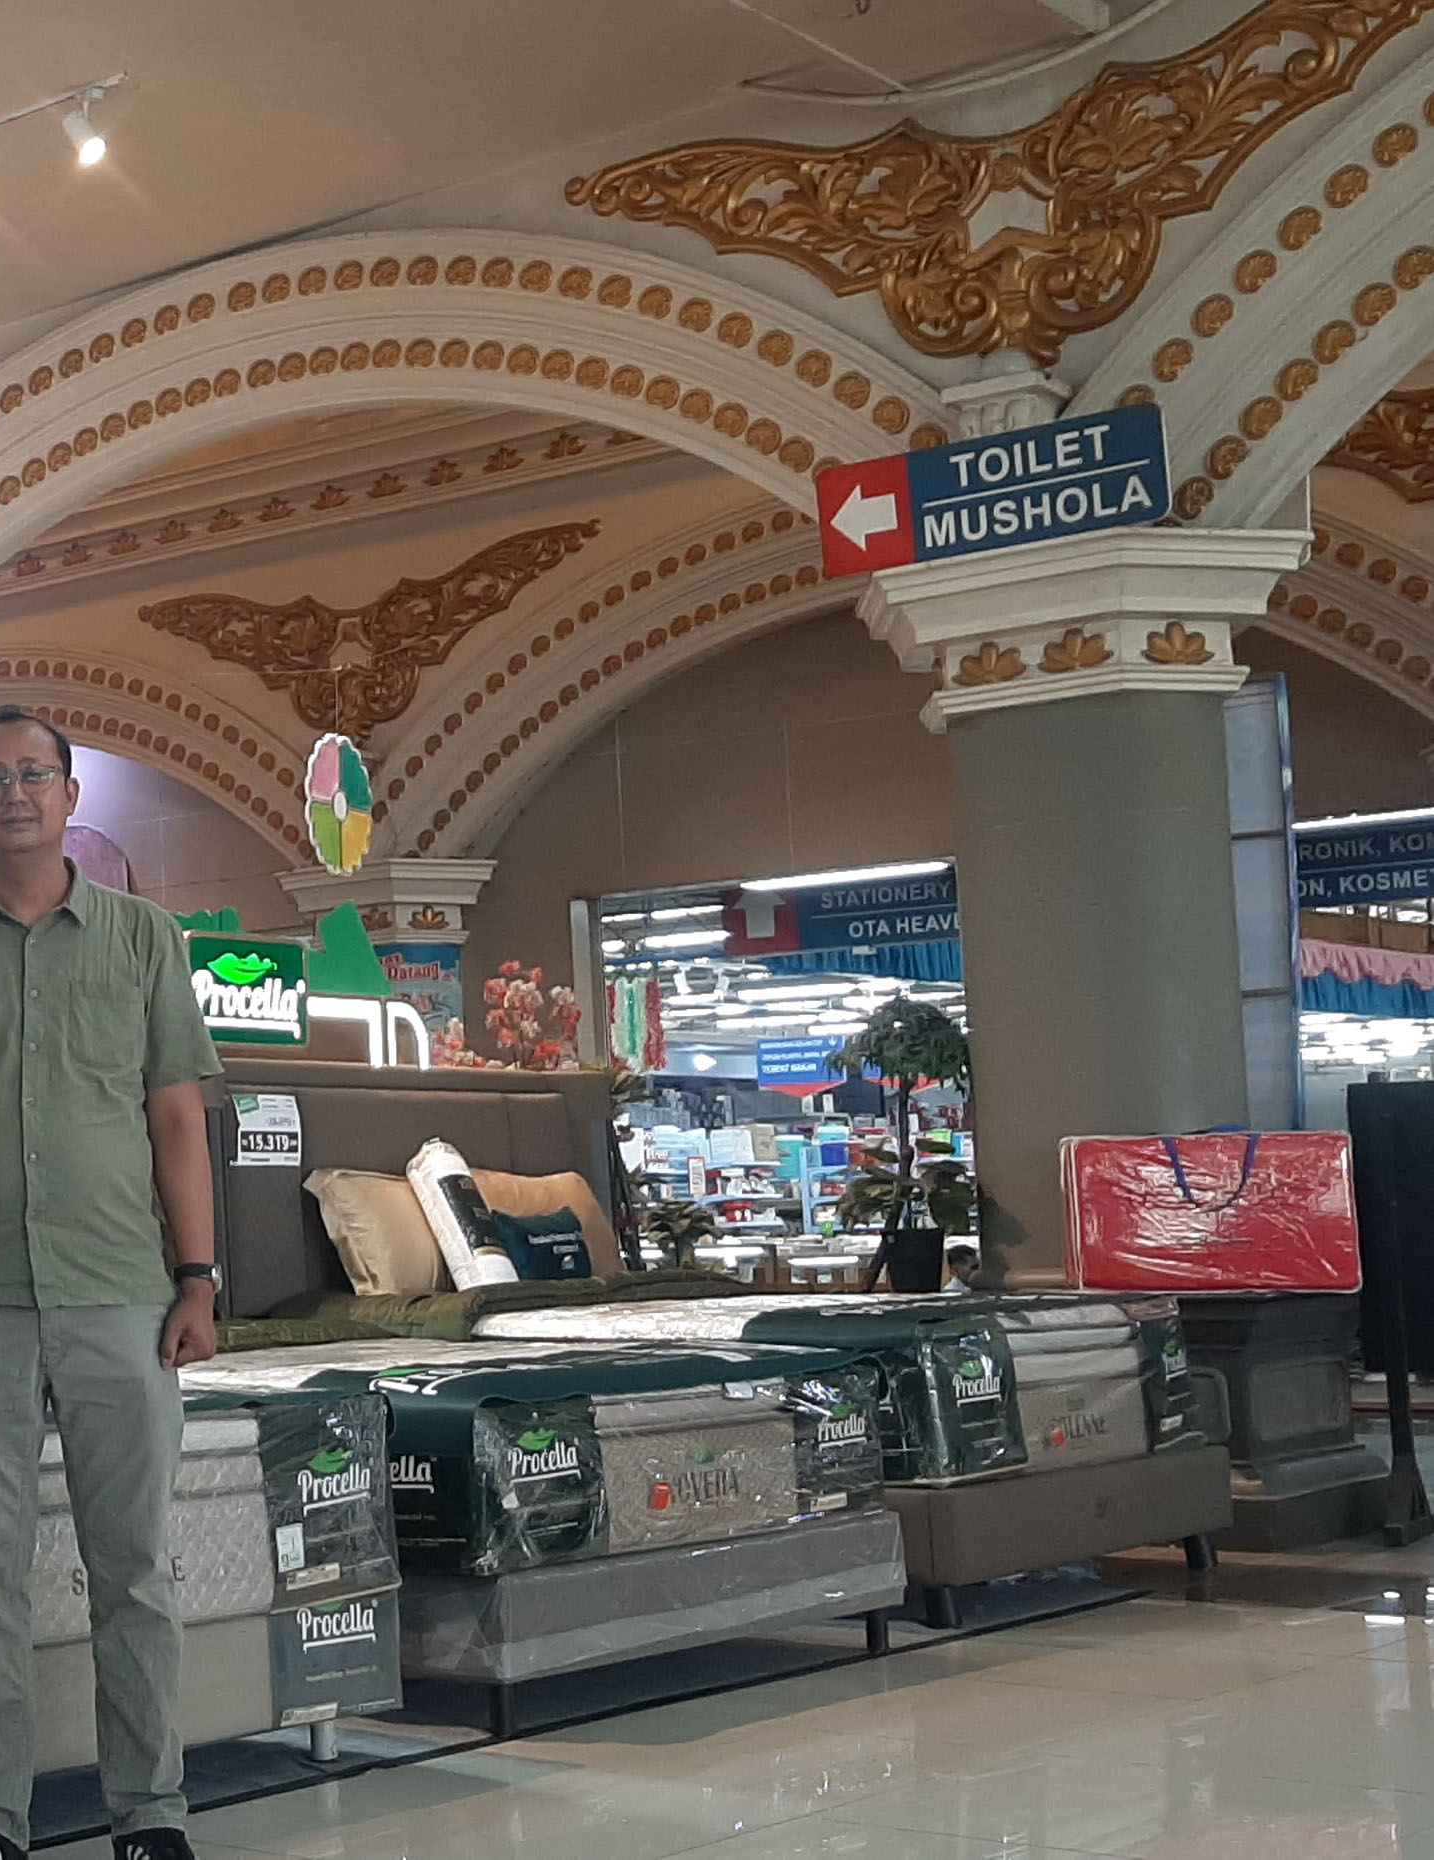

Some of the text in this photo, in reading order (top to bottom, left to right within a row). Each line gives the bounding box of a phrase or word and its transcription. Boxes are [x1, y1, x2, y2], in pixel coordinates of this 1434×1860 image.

[948, 424, 1111, 488] TOILET
[923, 475, 1154, 549] MUSHOLA
[820, 881, 951, 909] STATIONERY
[1339, 869, 1434, 893] KOSME
[848, 919, 892, 938] OTA
[191, 969, 299, 1020] Procella
[508, 1441, 579, 1477] Procella
[297, 1462, 371, 1503] Procella
[296, 1602, 374, 1640] Procella
